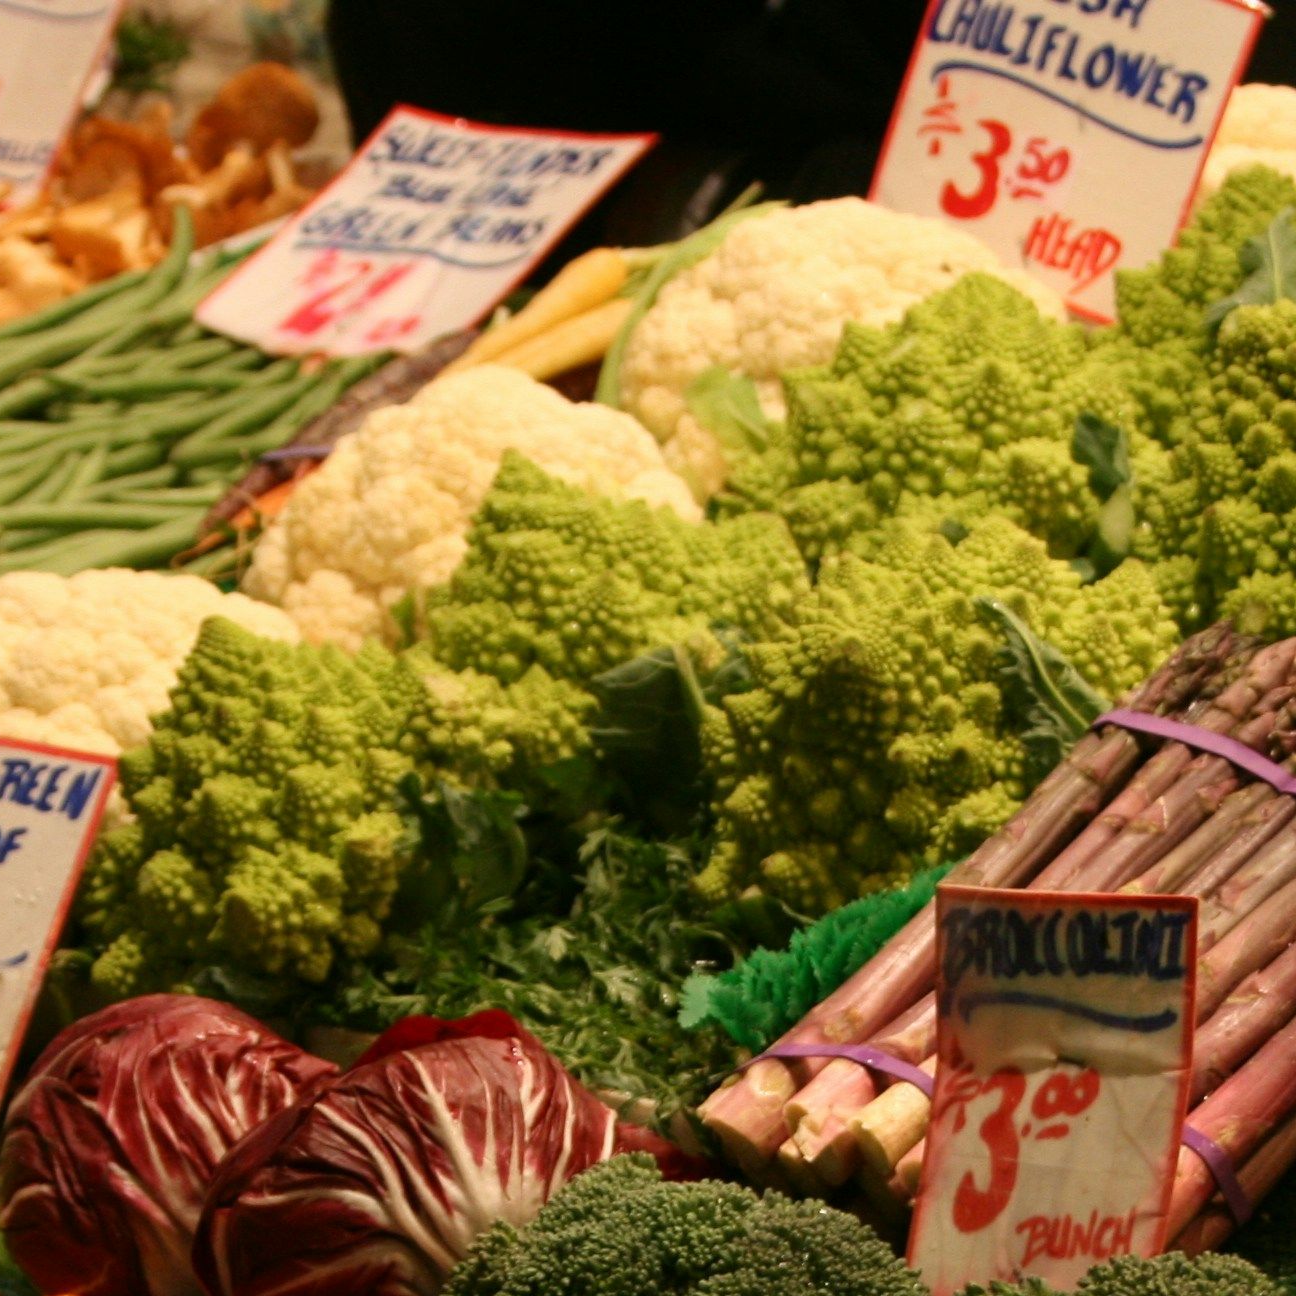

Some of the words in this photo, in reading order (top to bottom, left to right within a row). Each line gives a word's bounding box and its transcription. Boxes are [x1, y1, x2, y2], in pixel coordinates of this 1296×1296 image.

[927, 0, 1209, 124] CAULIFLOWER
[1023, 211, 1122, 292] HEAD
[1015, 1208, 1138, 1268] BUNCH
